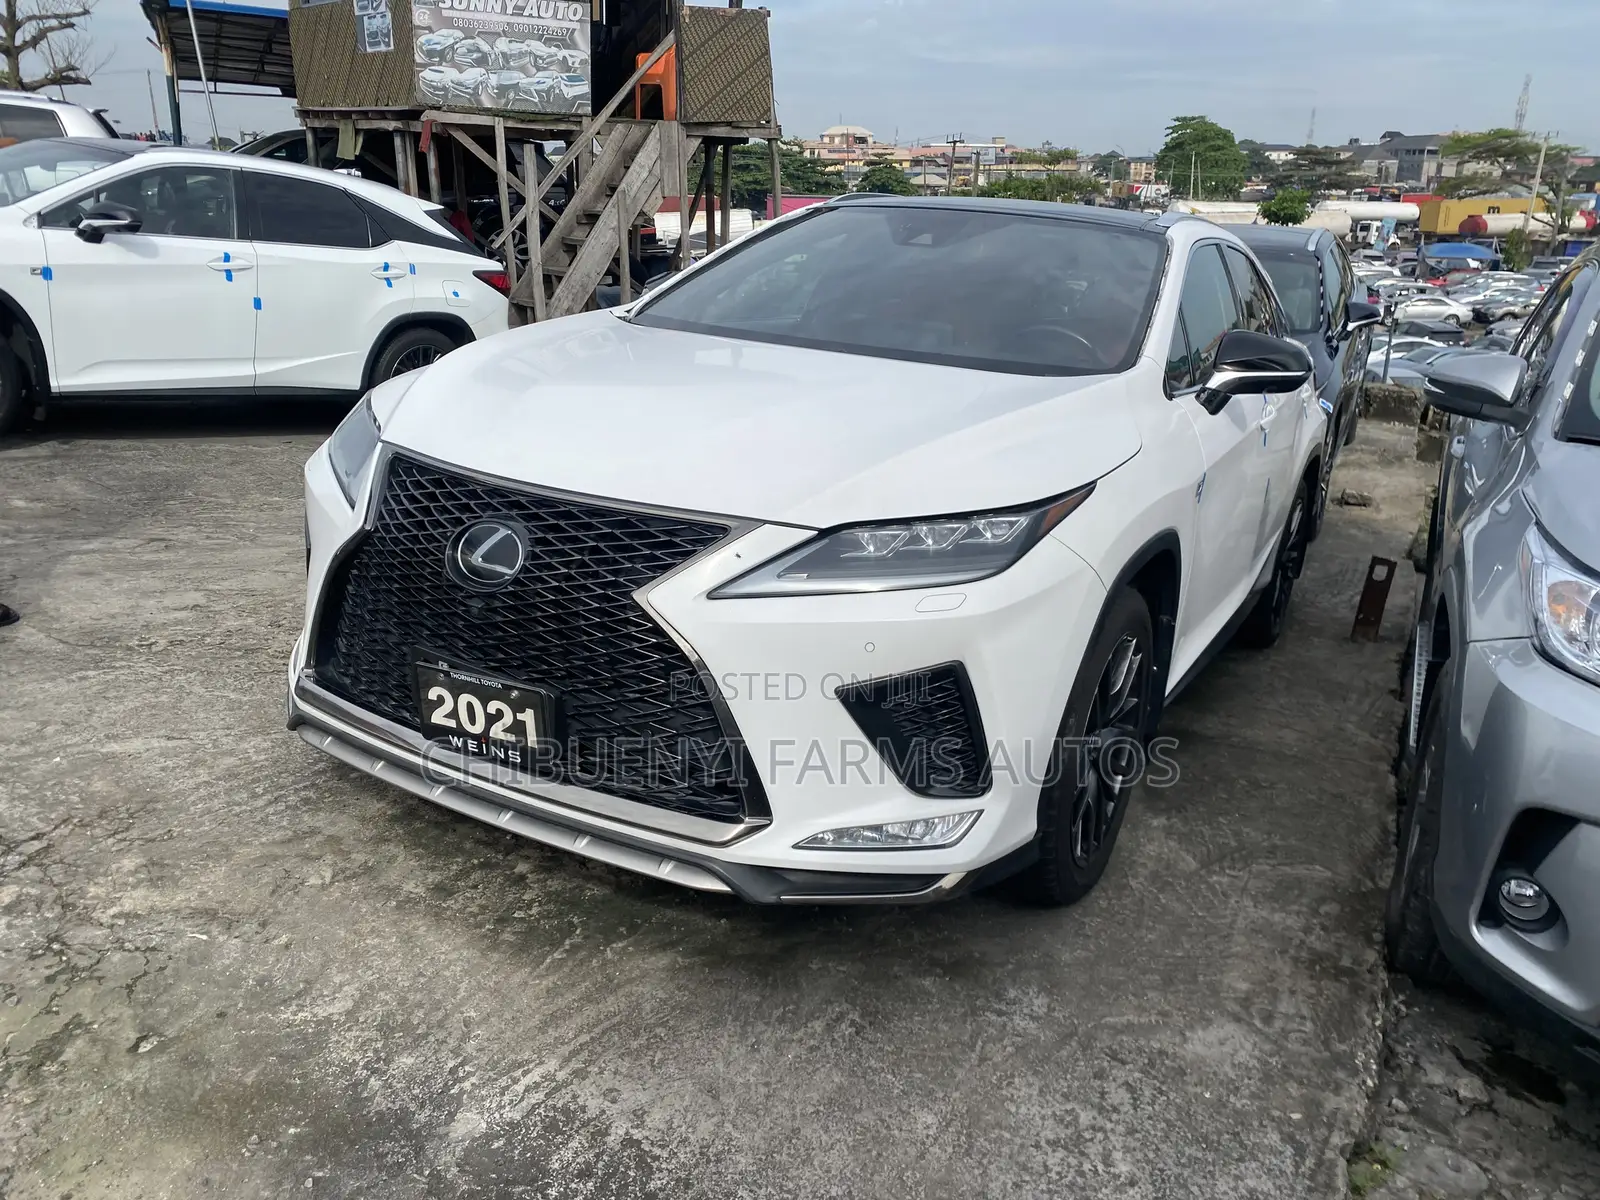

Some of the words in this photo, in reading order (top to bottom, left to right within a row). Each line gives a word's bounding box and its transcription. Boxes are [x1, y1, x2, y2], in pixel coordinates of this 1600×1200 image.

[522, 0, 583, 21] AUTO
[450, 672, 480, 685] THORNHILL
[481, 679, 502, 689] TOYOTA
[427, 686, 538, 748] 2021
